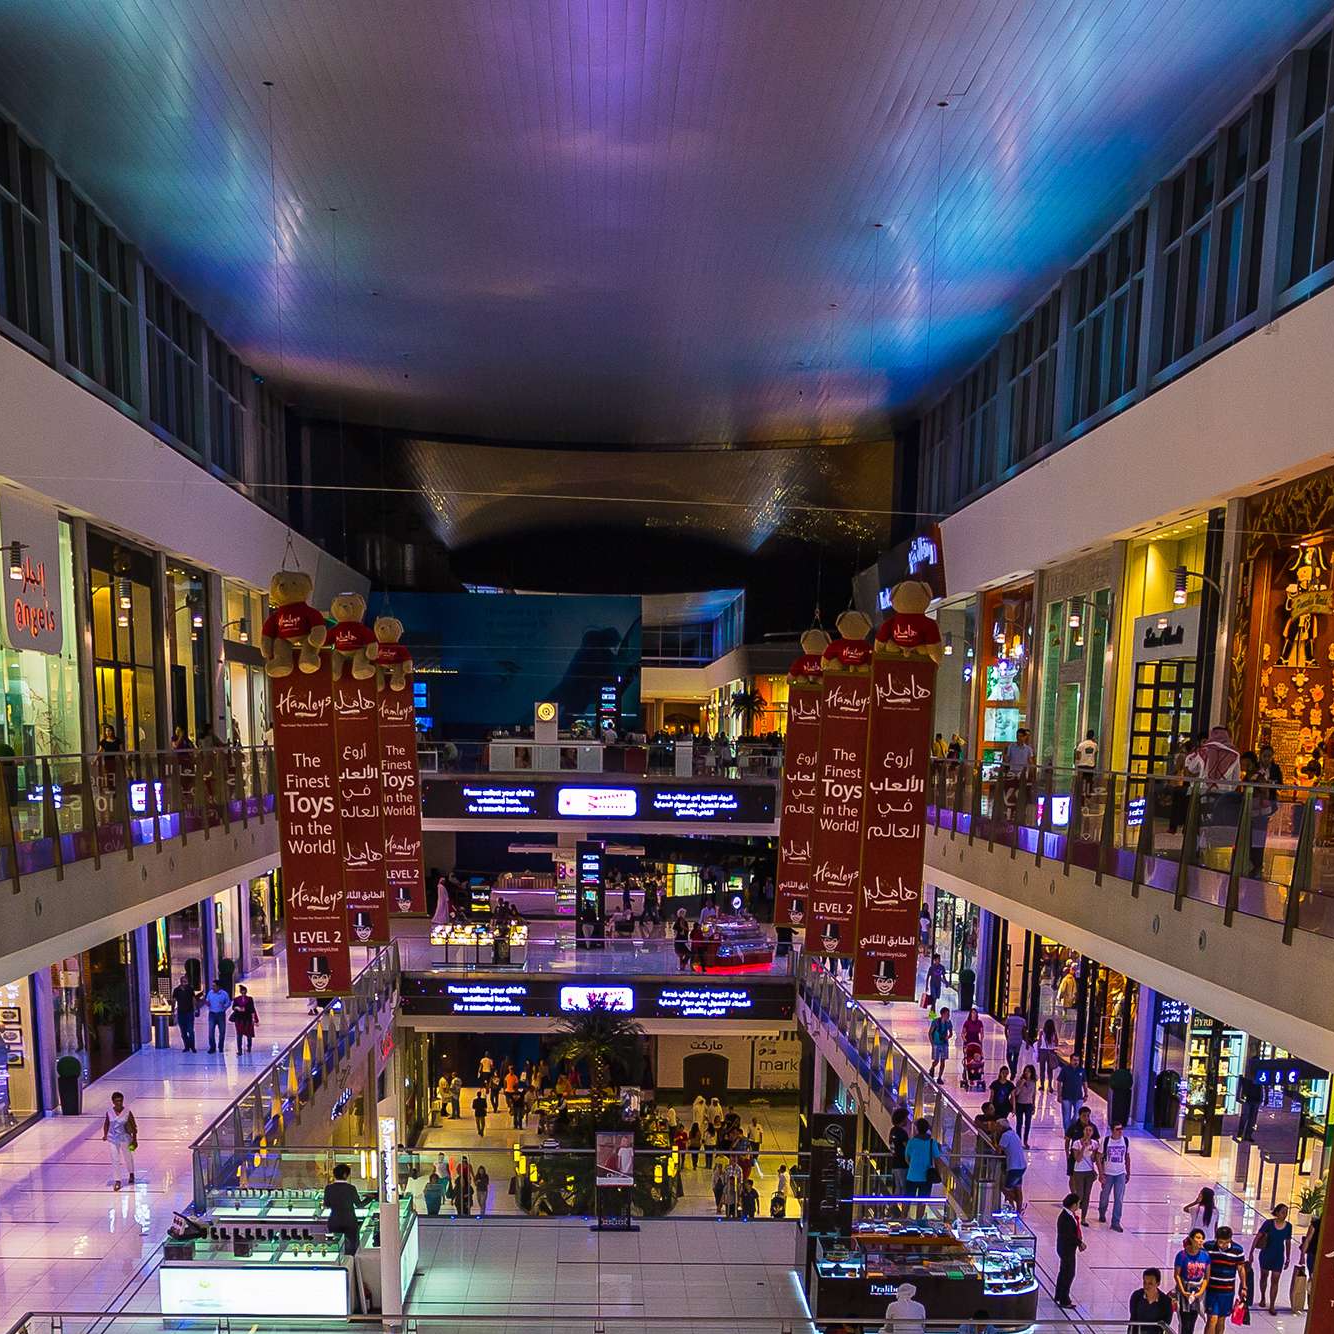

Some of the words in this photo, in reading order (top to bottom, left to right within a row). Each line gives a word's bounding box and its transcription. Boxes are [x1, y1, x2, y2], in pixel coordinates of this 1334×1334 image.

[15, 597, 56, 639] angels
[276, 686, 331, 718] Hamleys
[343, 742, 366, 760] أروع
[386, 745, 405, 755] The
[832, 748, 856, 761] The
[292, 753, 321, 767] The
[382, 760, 411, 770] Finest
[883, 748, 913, 768] أروع
[825, 765, 862, 779] Finest
[286, 775, 330, 788] Finest
[382, 772, 415, 791] Toys
[869, 774, 924, 794] الألعاب
[342, 784, 371, 801] في
[384, 793, 393, 802] in
[396, 792, 413, 802] the
[822, 779, 863, 803] Toys
[284, 792, 334, 819] Toys
[383, 806, 416, 816] World!
[823, 804, 833, 815] in
[838, 804, 858, 816] the
[878, 798, 913, 817] في
[290, 822, 303, 835] in
[308, 821, 332, 835] the
[819, 818, 859, 833] World!
[867, 824, 920, 840] العالم
[288, 840, 335, 854] World!
[385, 835, 420, 856] Hamleys
[387, 870, 411, 879] LEVEL
[414, 870, 419, 878] 2
[813, 861, 859, 887] Hamleys
[287, 880, 343, 912] Hamleys
[813, 902, 843, 914] LEVEL
[847, 904, 853, 914] 2
[293, 931, 330, 943] LEVEL
[334, 931, 341, 943] 2
[860, 934, 886, 948] الثاني
[887, 936, 915, 947] الطابق
[691, 1041, 723, 1051] ماركت
